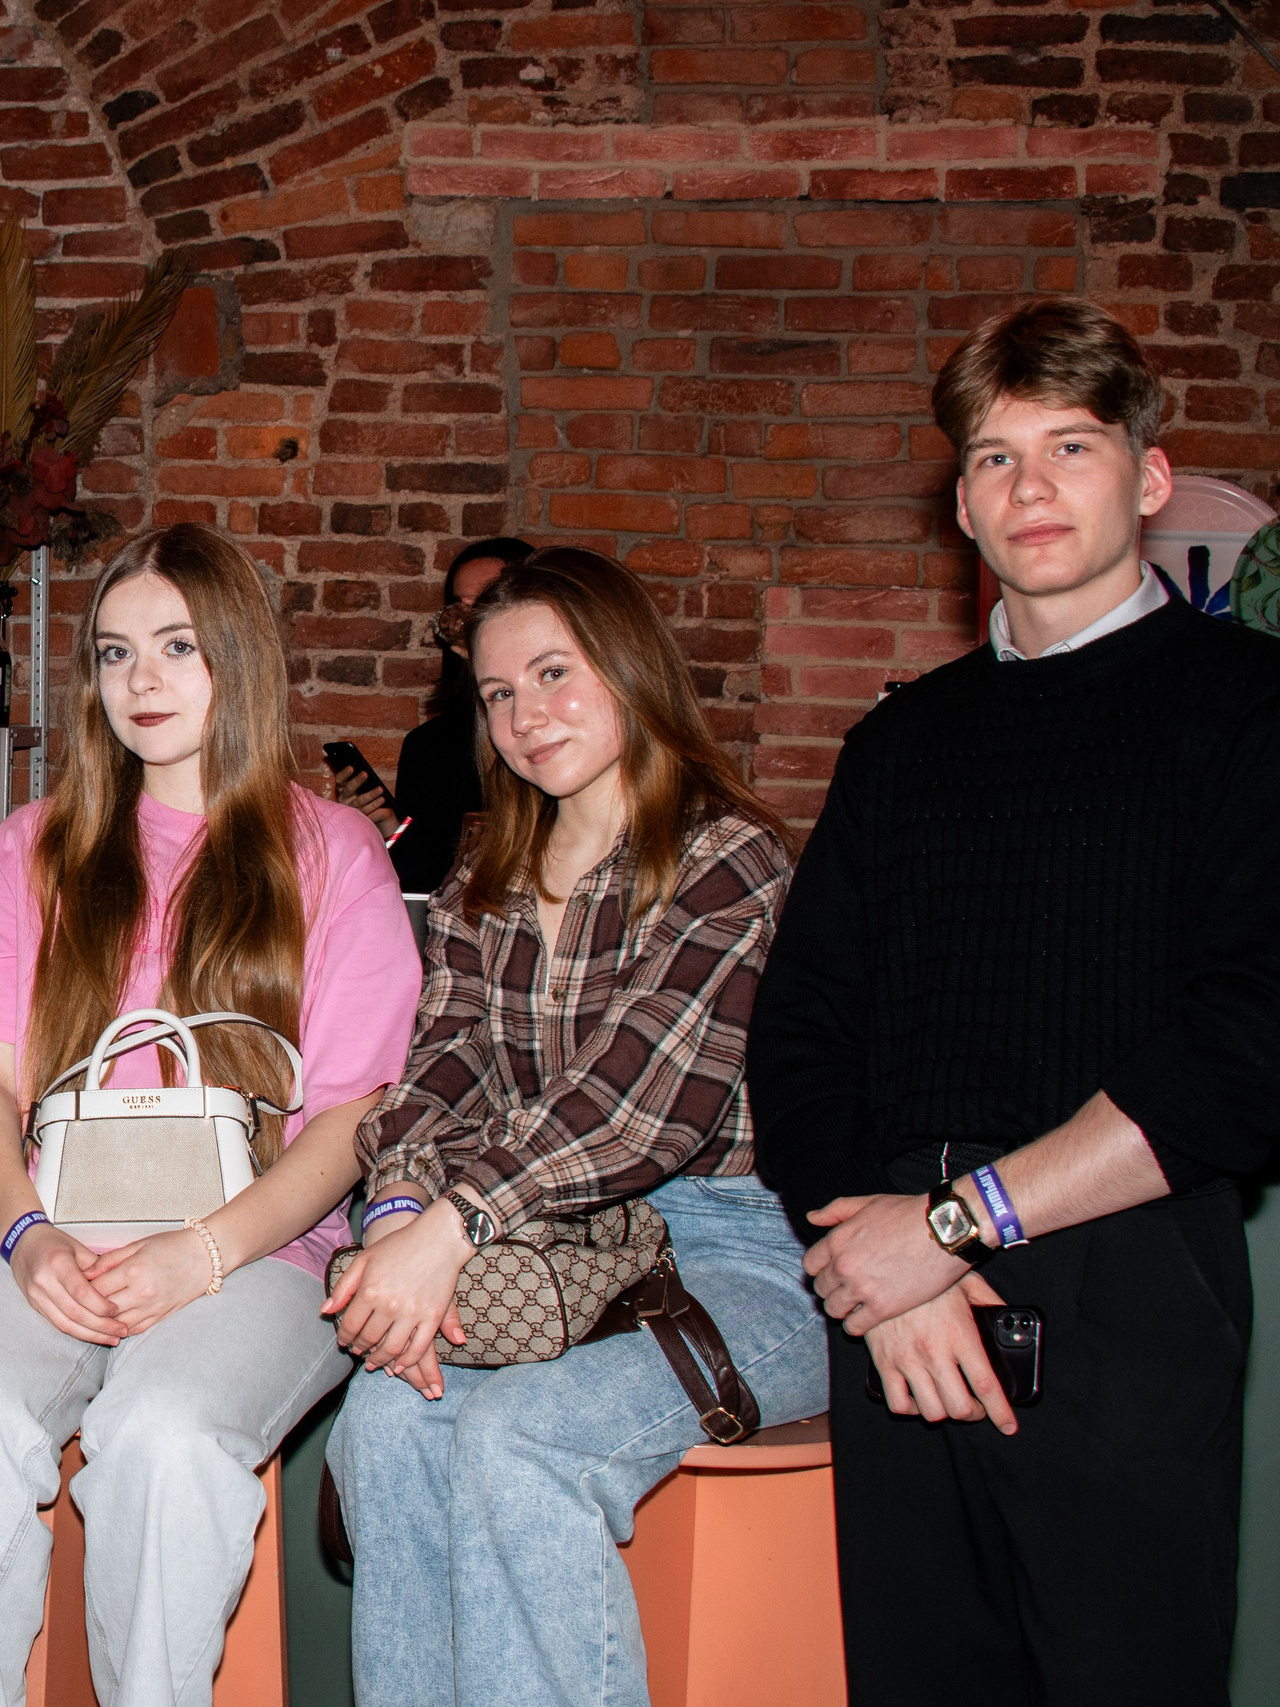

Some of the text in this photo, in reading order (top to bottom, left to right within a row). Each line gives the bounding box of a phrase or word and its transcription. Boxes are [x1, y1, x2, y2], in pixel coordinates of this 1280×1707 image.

[122, 1095, 161, 1104] GUESS
[979, 1173, 1009, 1218] ЛУЧШИХ
[362, 1201, 393, 1228] СХОДКА
[5, 1216, 34, 1250] СХОДКА
